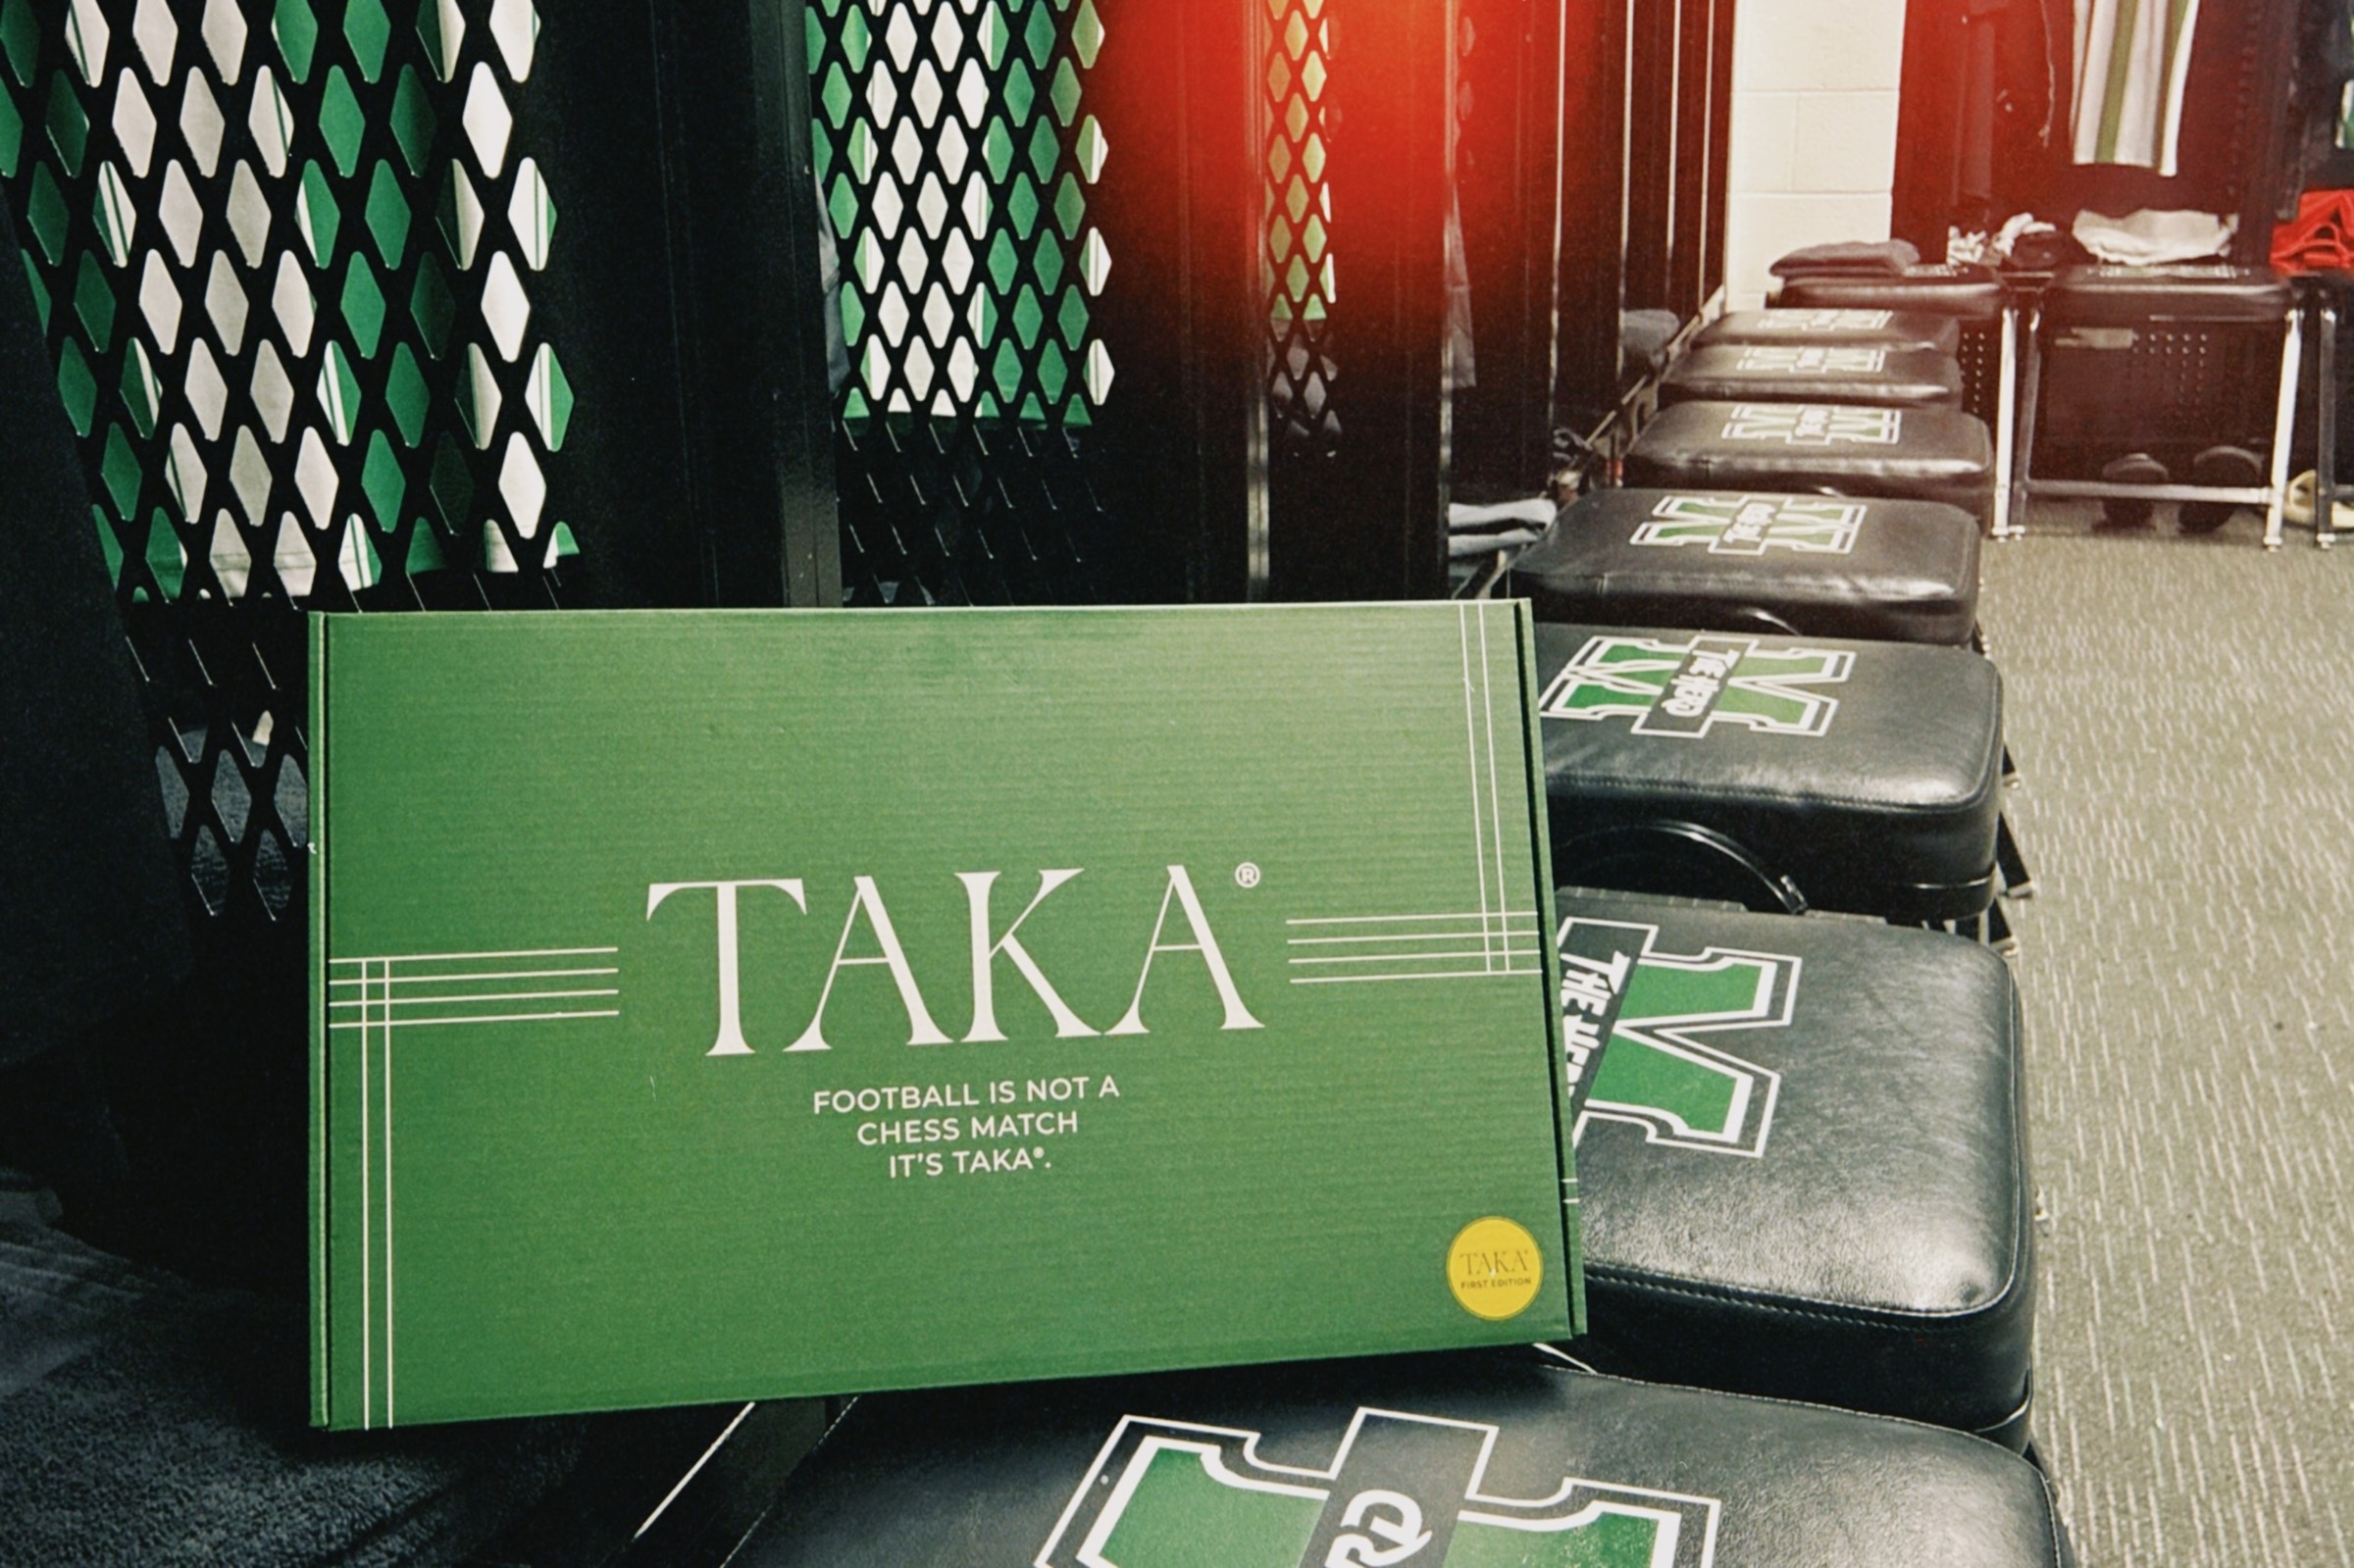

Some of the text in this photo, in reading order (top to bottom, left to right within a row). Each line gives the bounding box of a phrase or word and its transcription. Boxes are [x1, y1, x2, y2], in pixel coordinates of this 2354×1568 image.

[813, 1075, 1120, 1115] FOOTBALL IS NOT A
[856, 1110, 1078, 1146] CHESS MATCH
[890, 1152, 944, 1179] IT'S
[1460, 1277, 1532, 1290] FIRST EDITION
